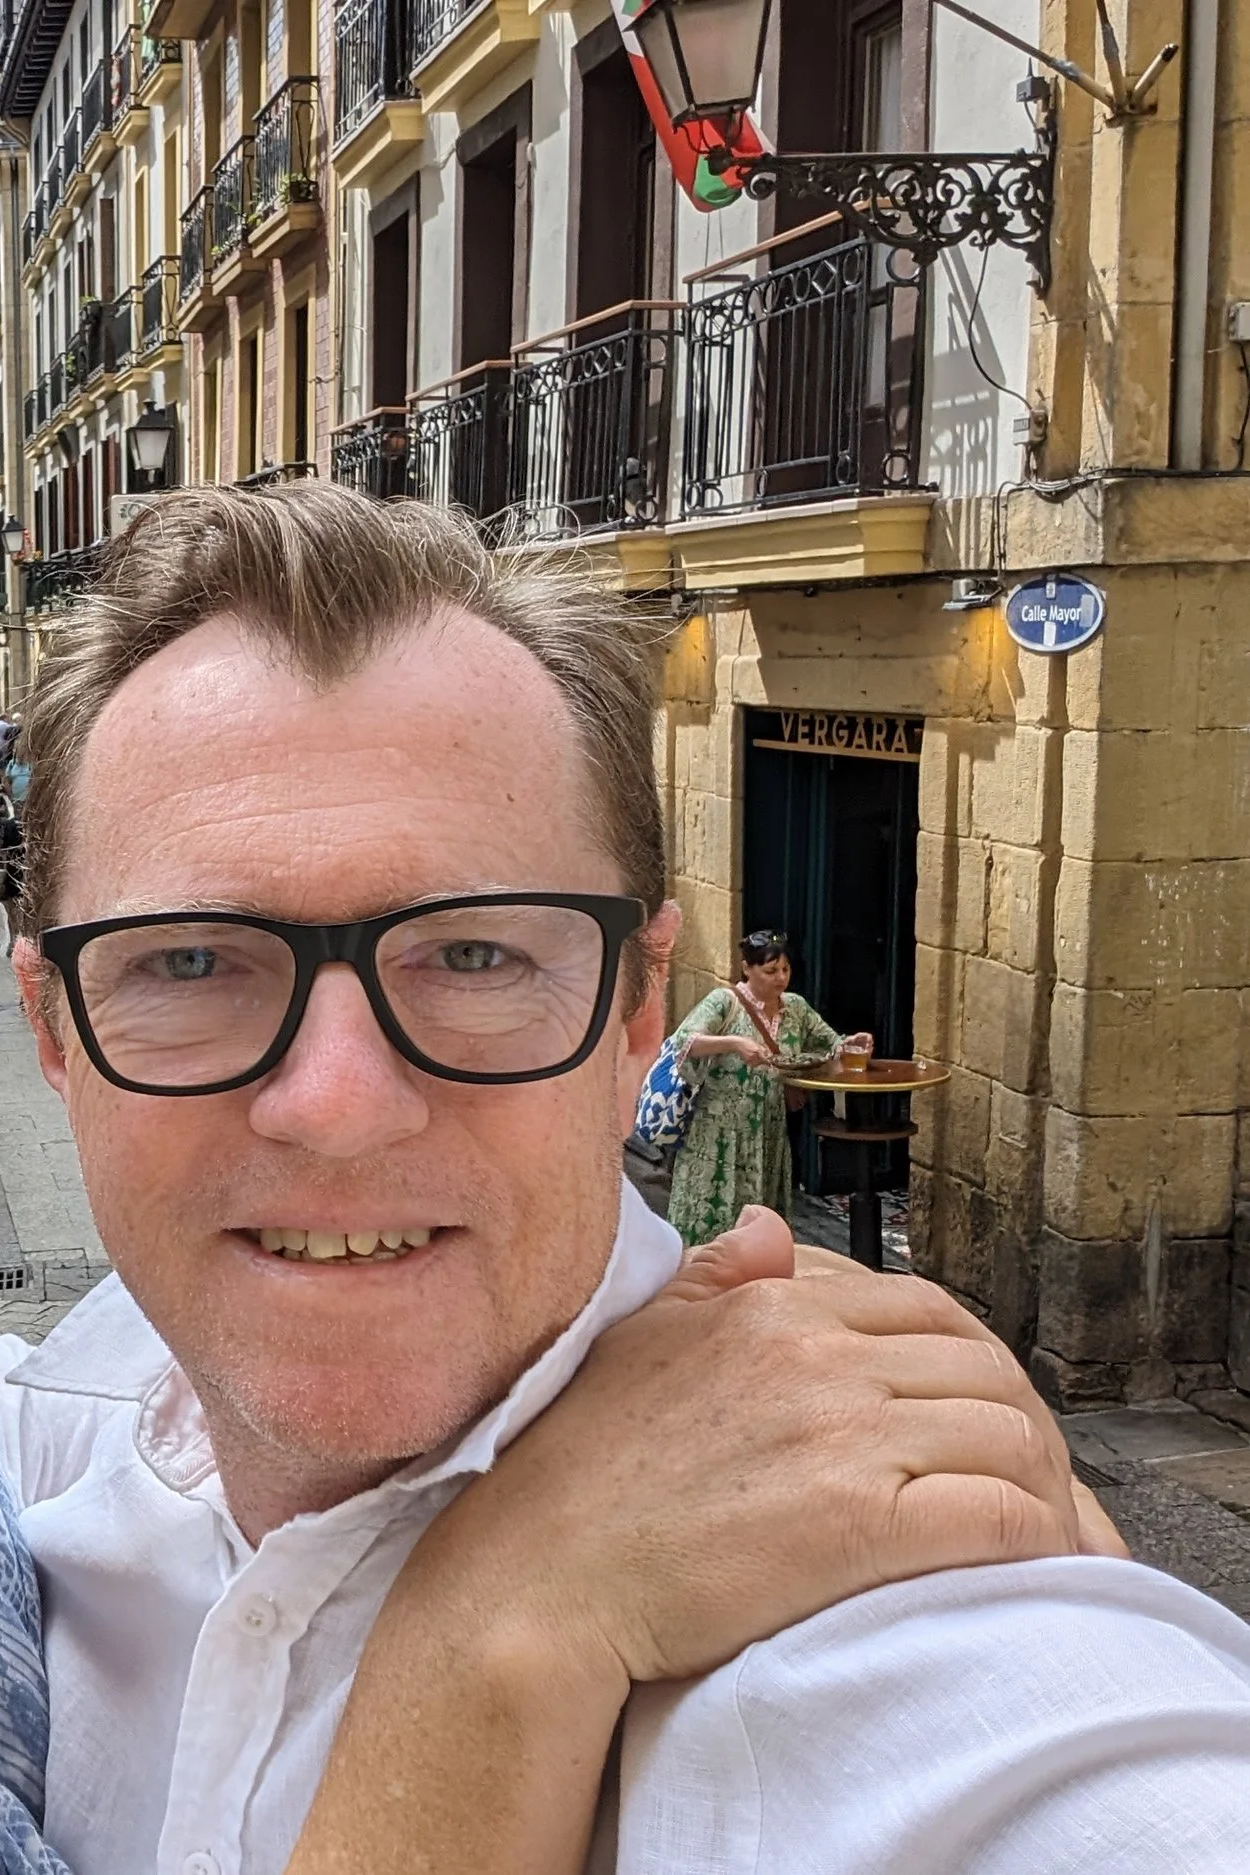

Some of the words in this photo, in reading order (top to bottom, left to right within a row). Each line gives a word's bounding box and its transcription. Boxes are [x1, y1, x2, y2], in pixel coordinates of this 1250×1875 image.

[1021, 605, 1047, 622] Calle
[1049, 604, 1081, 625] Mayor
[780, 711, 909, 754] VERGARA
